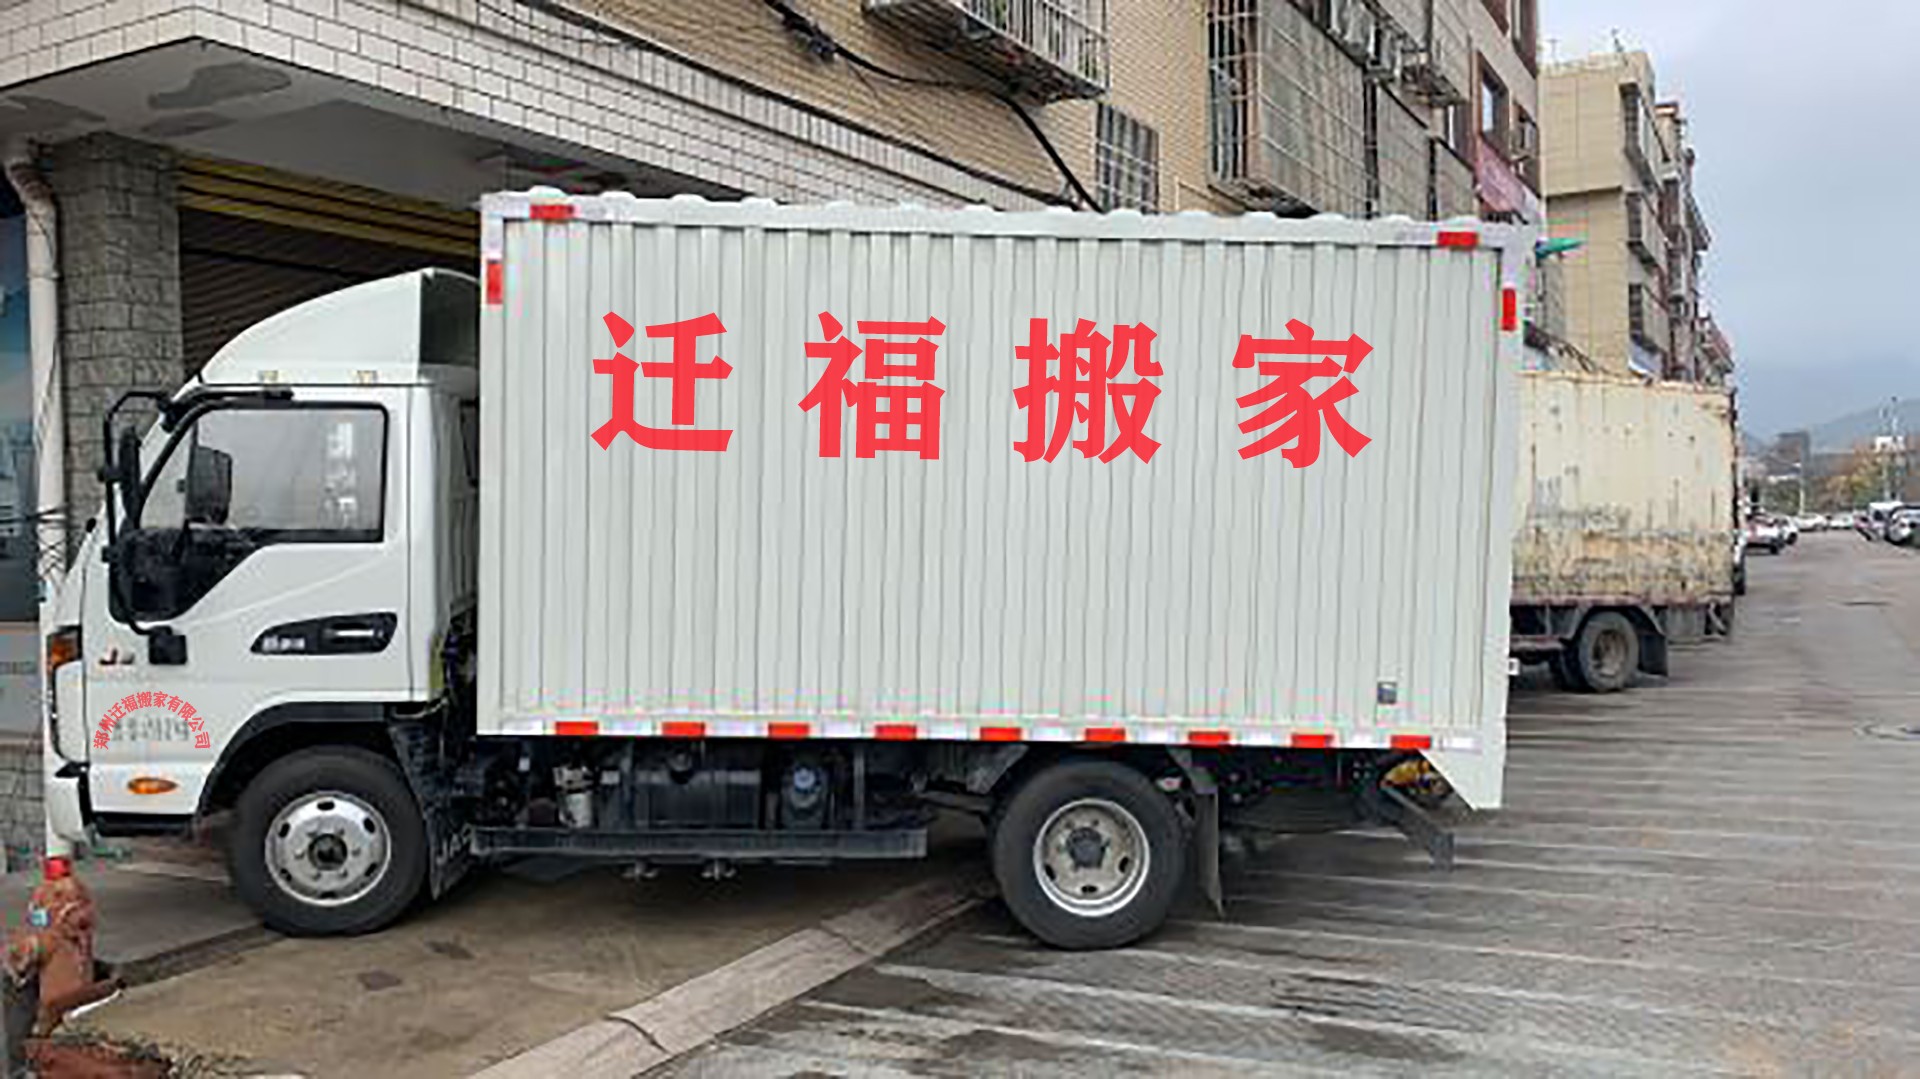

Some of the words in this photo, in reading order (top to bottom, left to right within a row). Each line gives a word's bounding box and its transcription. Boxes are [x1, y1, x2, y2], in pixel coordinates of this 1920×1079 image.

[591, 311, 1374, 468] 迁福搬家
[93, 691, 211, 749] 郑州迁福搬家有限公司
